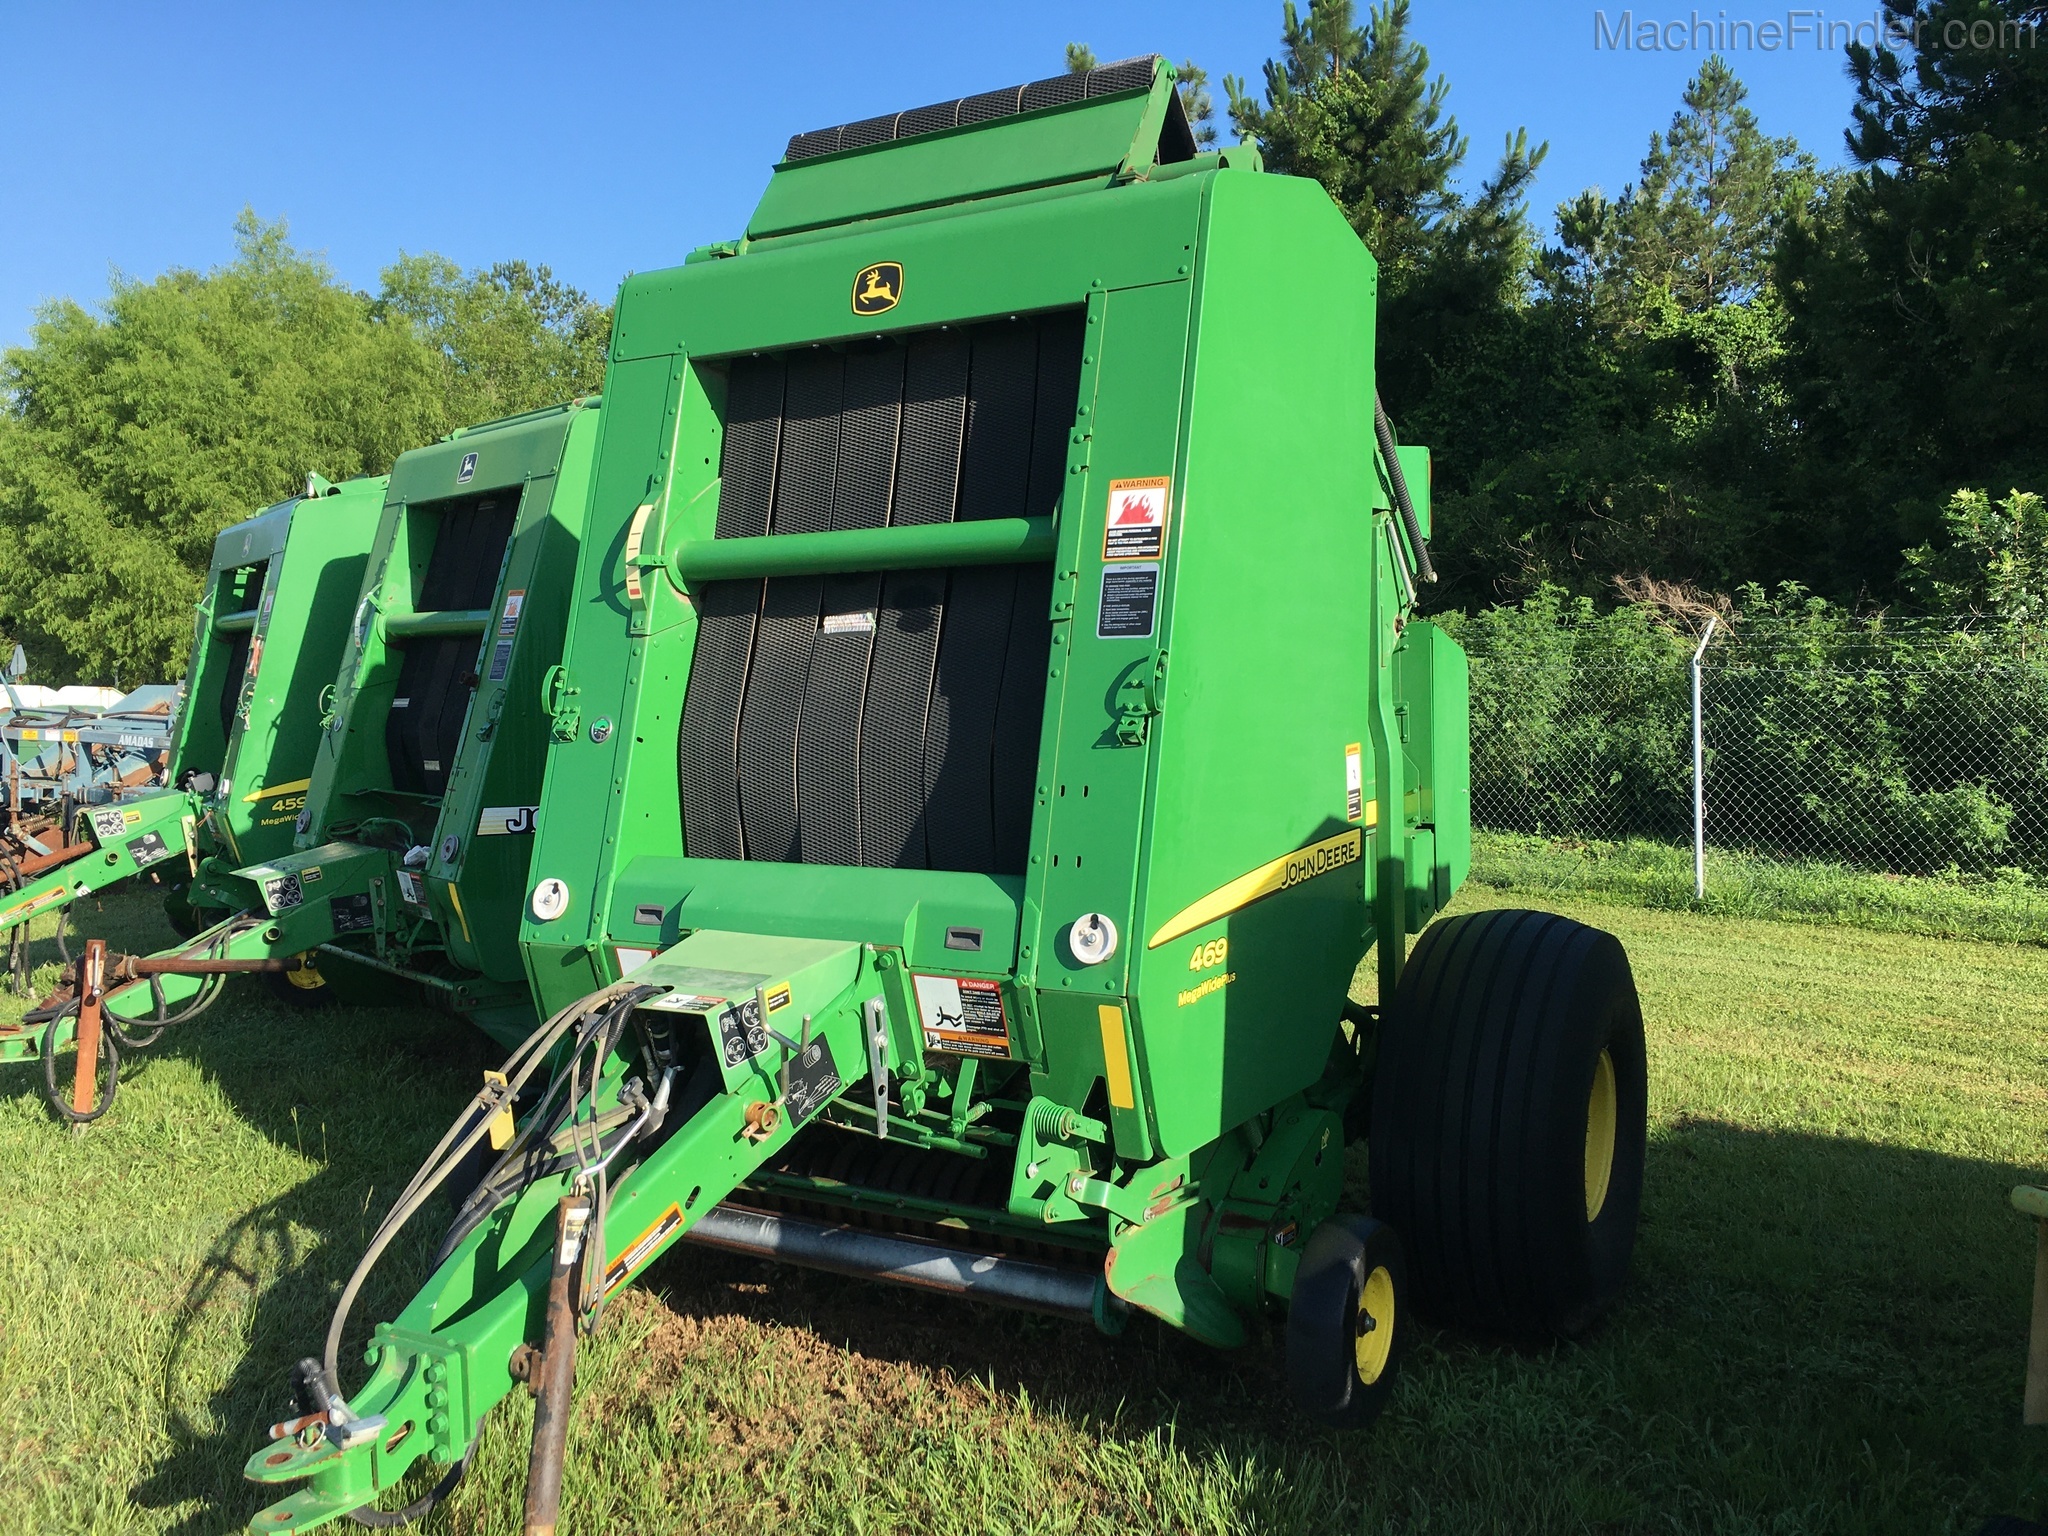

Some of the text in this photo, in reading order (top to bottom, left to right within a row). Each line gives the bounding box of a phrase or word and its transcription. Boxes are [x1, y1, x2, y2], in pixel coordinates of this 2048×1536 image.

[1122, 478, 1164, 488] WARNING
[118, 735, 153, 748] AMADAS
[1281, 841, 1355, 887] JOHN DEERE
[1189, 936, 1228, 972] 469
[968, 981, 995, 990] DANGER
[1178, 971, 1236, 1008] MegaWidePlus
